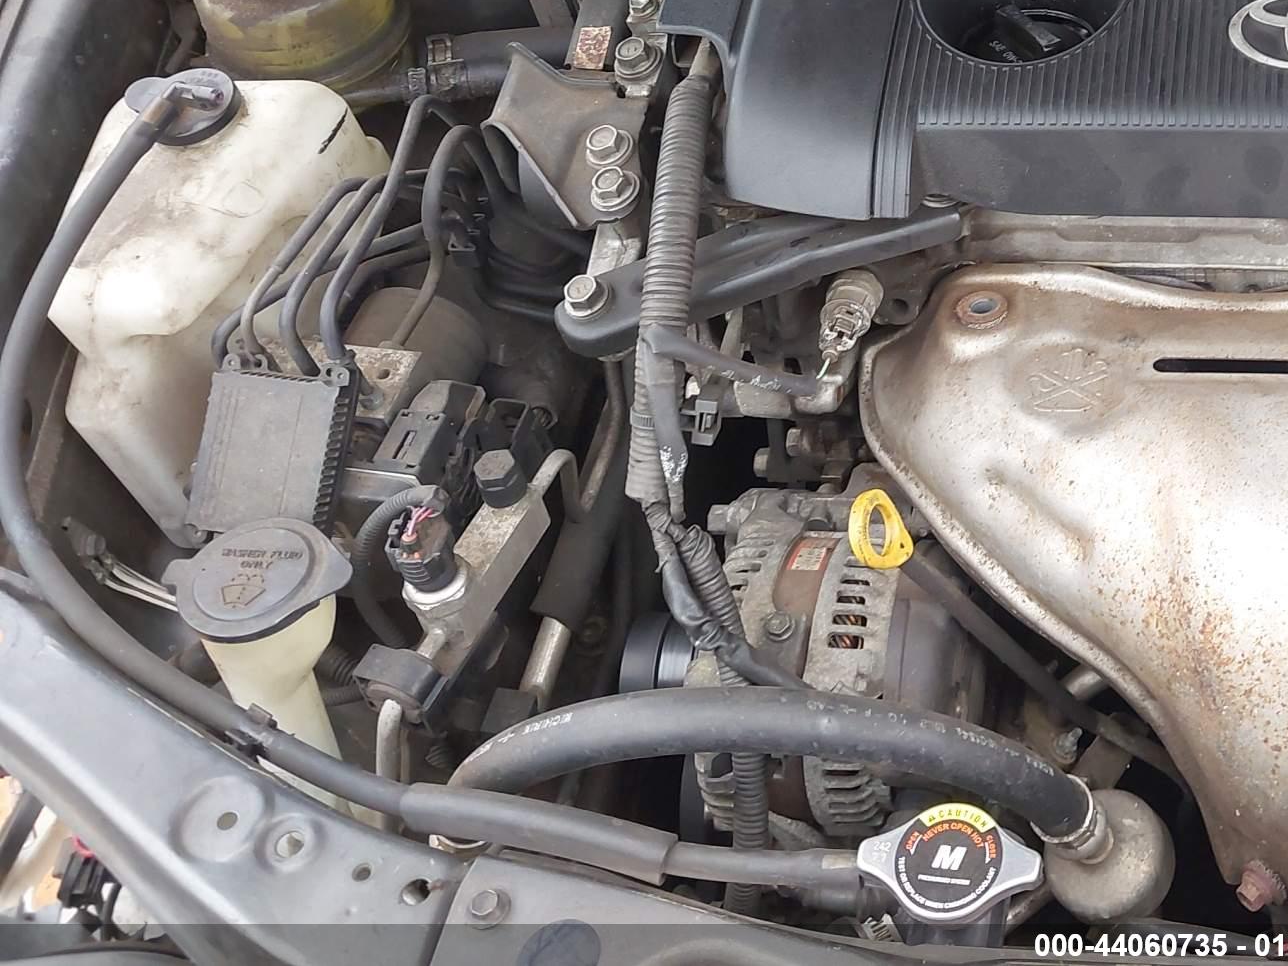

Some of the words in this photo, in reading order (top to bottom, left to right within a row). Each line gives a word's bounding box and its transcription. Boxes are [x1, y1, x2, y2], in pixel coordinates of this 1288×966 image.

[1002, 51, 1024, 64] 0W-
[938, 809, 988, 828] CAUTION
[922, 822, 949, 842] NEVER
[950, 822, 973, 835] OPEN
[970, 831, 985, 848] HOT
[930, 844, 967, 871] M
